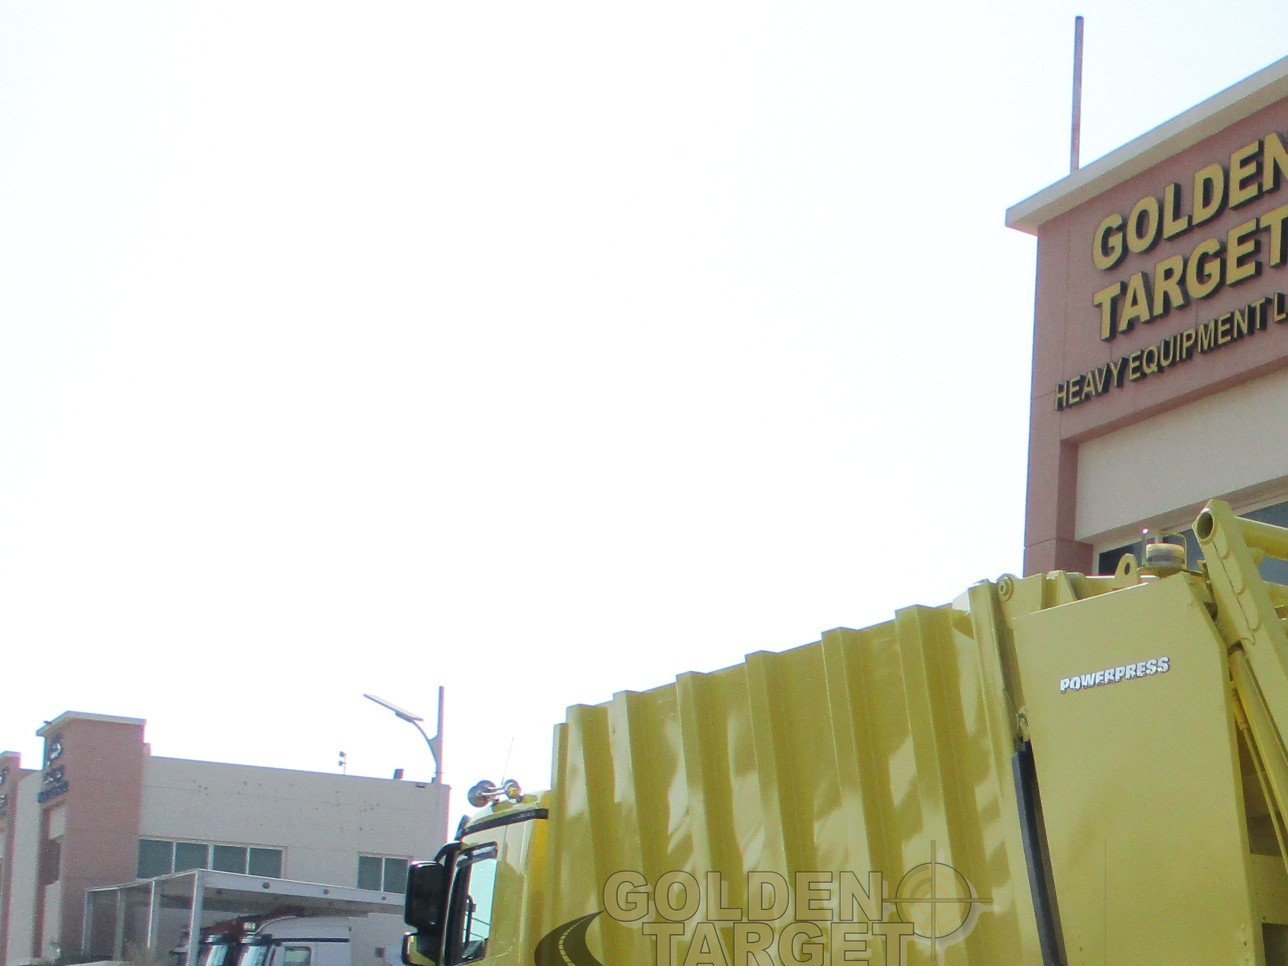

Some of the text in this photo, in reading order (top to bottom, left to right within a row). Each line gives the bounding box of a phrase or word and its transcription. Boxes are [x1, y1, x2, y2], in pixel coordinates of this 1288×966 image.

[1054, 357, 1128, 411] HEAVY
[1128, 299, 1267, 381] EQUIPMENT
[1059, 656, 1170, 694] POWERPRESS
